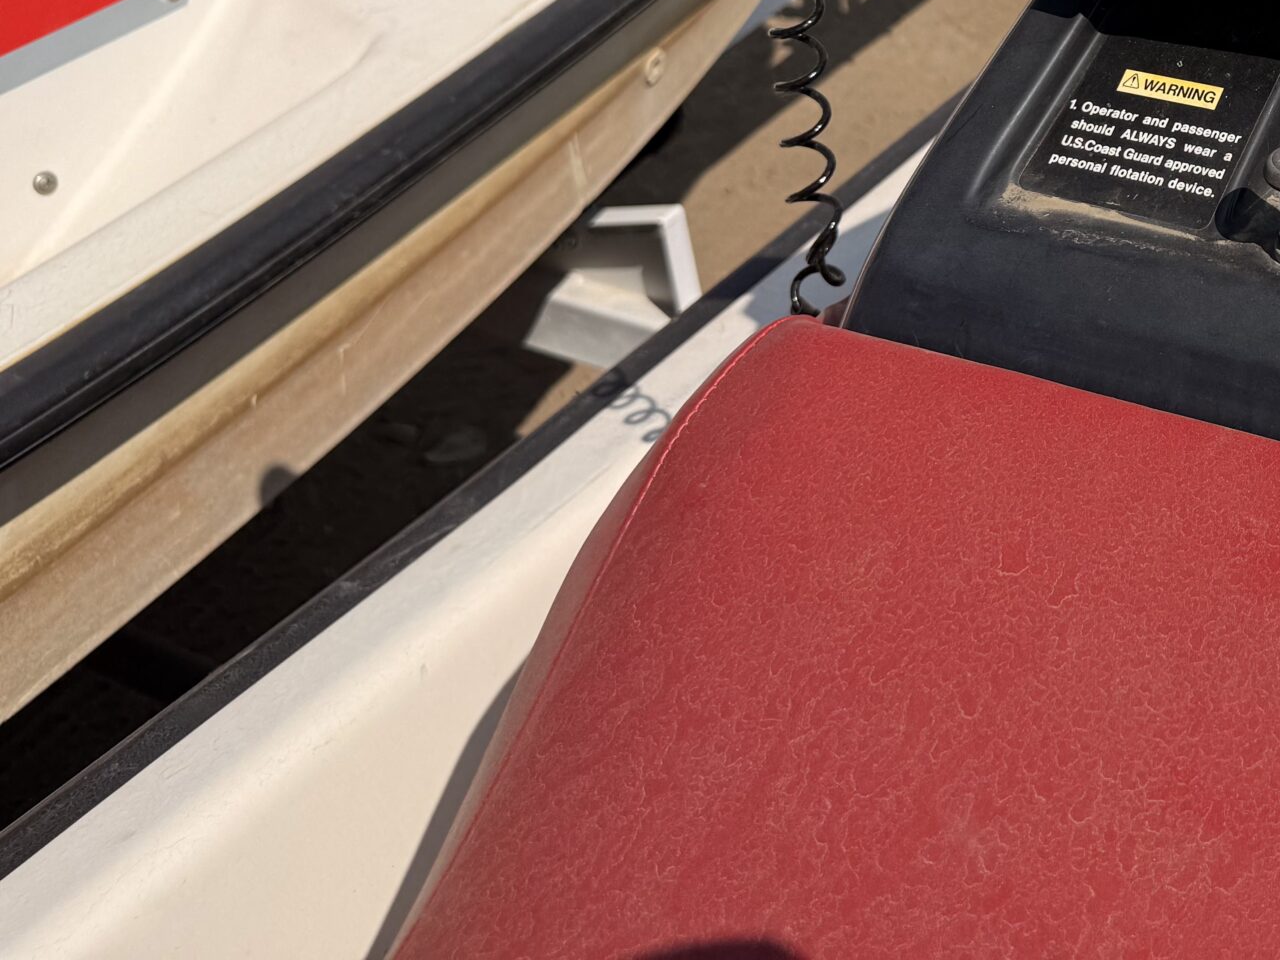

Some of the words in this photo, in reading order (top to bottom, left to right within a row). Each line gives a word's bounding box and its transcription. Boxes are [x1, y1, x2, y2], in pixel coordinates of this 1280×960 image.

[1144, 78, 1218, 103] WARNING
[1069, 98, 1077, 110] 1.
[1082, 101, 1139, 122] Operator
[1143, 116, 1169, 129] and
[1172, 121, 1242, 144] passenger
[1071, 119, 1115, 136] should
[1121, 129, 1177, 149] ALWAYS
[1184, 143, 1217, 158] wear
[1223, 151, 1233, 162] a
[1048, 152, 1107, 174] personal
[1110, 164, 1165, 186] flotation
[1168, 178, 1216, 198] device.
[1123, 149, 1163, 166] Guard
[1164, 159, 1226, 180] approved
